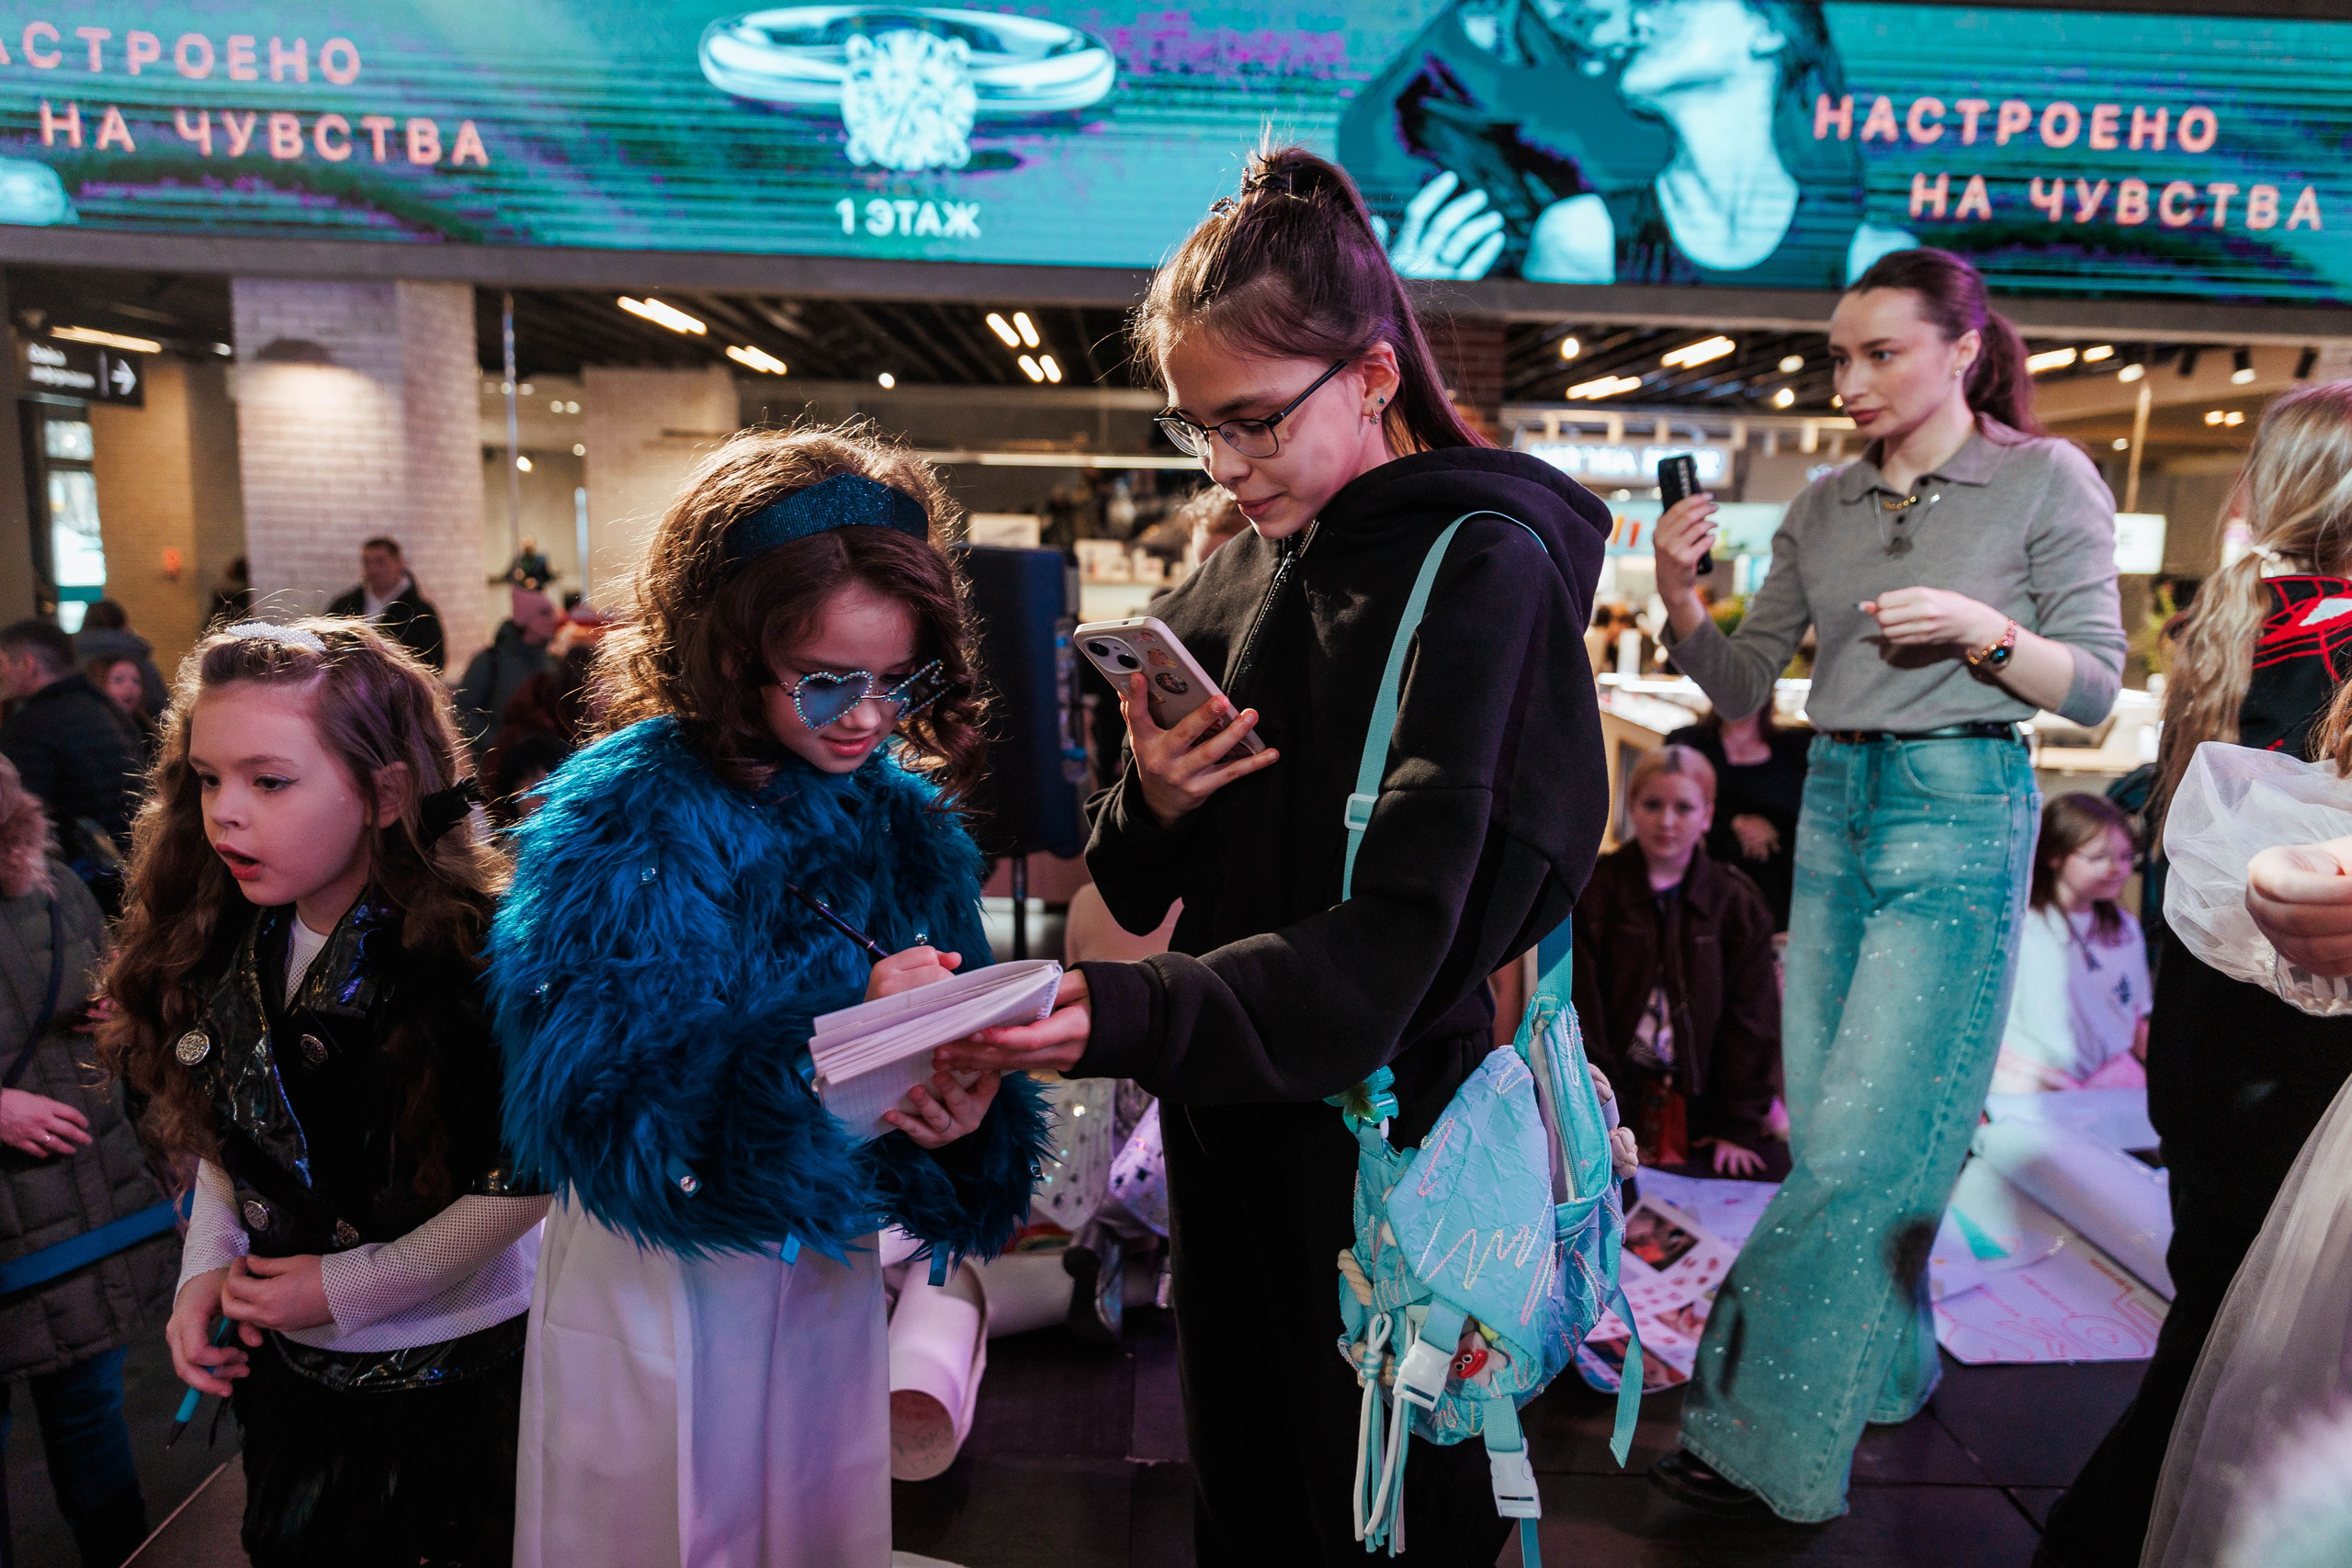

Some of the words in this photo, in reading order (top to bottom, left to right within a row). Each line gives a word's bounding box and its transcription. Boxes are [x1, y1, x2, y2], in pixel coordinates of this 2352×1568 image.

[40, 100, 137, 151] НА
[175, 107, 490, 167] ЧУВСТВА
[1813, 93, 2220, 153] НАСТРОЕНО
[835, 197, 855, 235] 1
[865, 198, 981, 239] ЭТАЖ
[1908, 172, 1993, 221] НА
[2028, 175, 2323, 231] ЧУВСТВА
